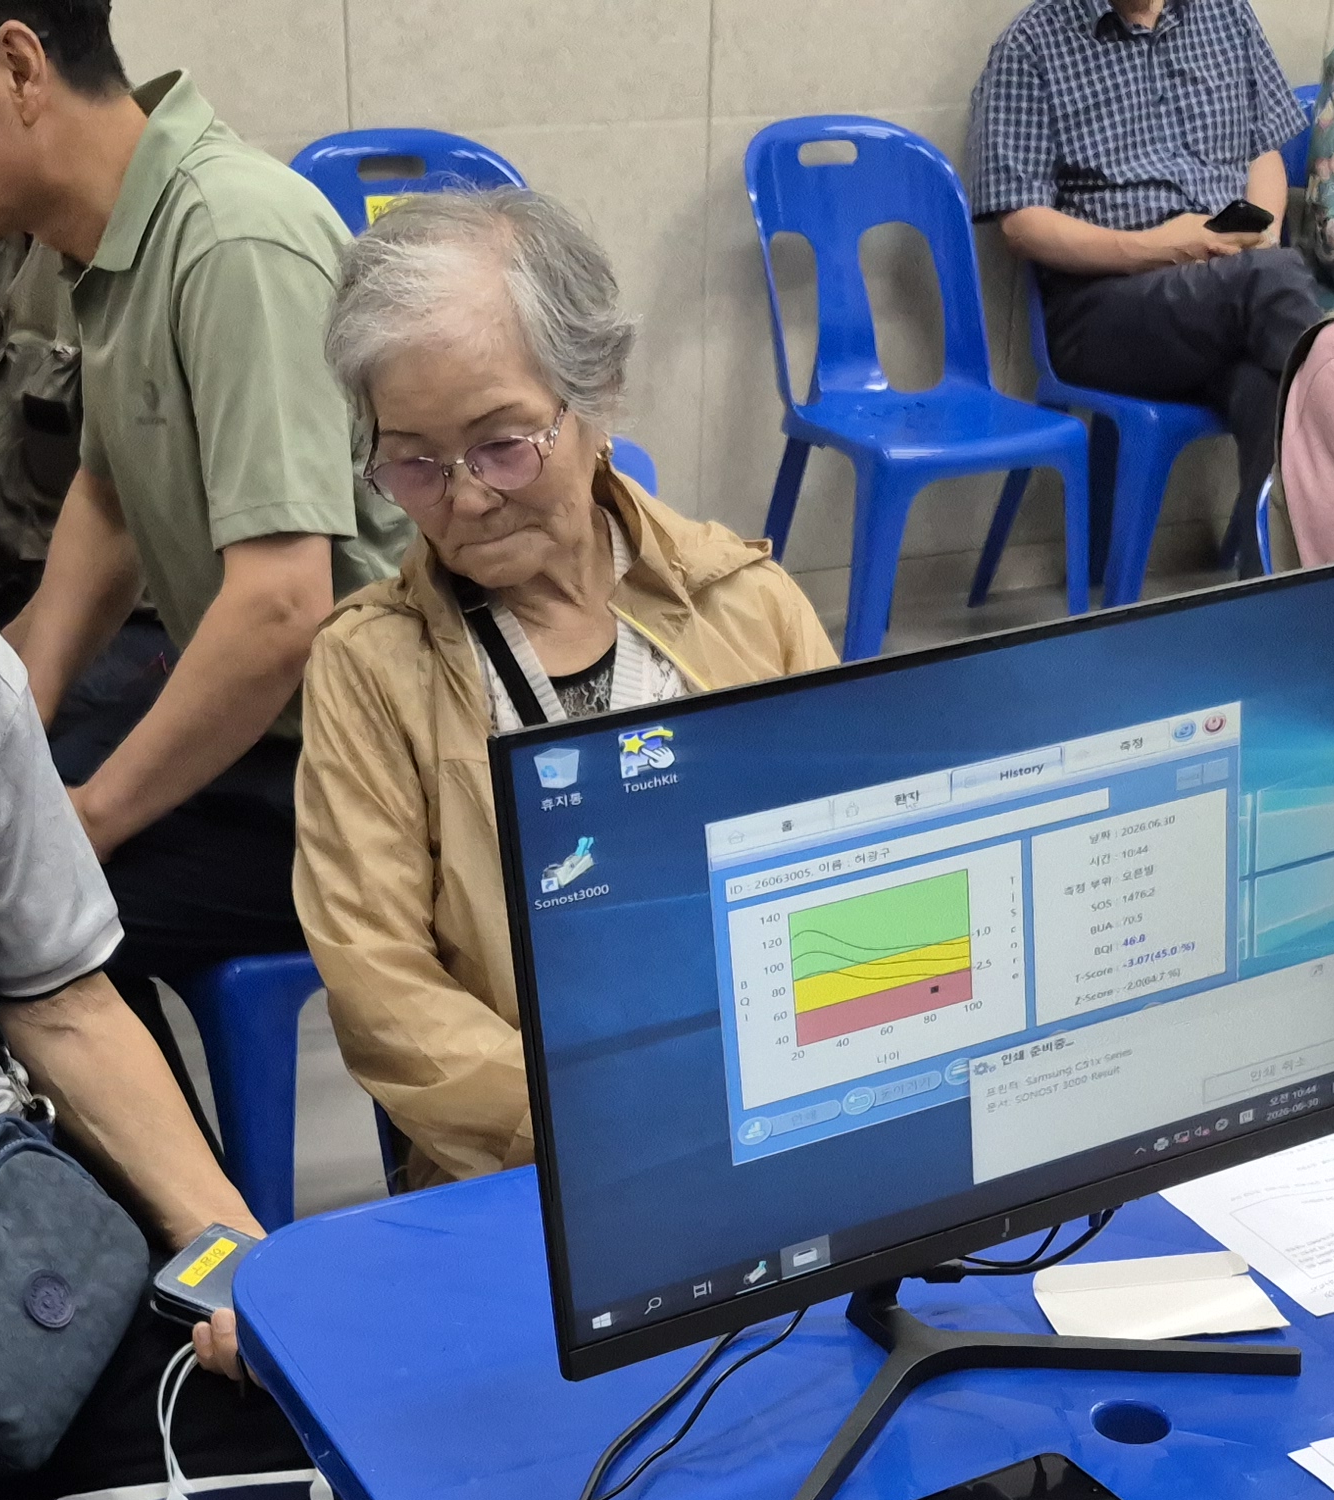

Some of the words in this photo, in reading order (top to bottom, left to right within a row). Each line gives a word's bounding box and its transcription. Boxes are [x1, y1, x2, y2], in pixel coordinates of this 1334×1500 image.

[999, 763, 1045, 781] History
[623, 773, 679, 794] TouchKit
[541, 792, 583, 811] 휴지통
[729, 883, 743, 896] ID
[818, 860, 842, 874] 이름
[534, 884, 610, 910] Sonost3000
[1091, 899, 1112, 913] SOS
[759, 912, 781, 925] 140
[1090, 921, 1114, 936] BUA
[761, 937, 783, 950] 120
[1094, 944, 1113, 957] BQI
[763, 962, 785, 975] 100
[771, 986, 787, 998] 80
[772, 1010, 788, 1022] 60
[790, 1050, 806, 1062] 20
[835, 1037, 850, 1049] 40
[879, 1025, 895, 1037] 60
[923, 1012, 938, 1024] 80
[963, 1000, 983, 1014] 100
[774, 1034, 790, 1046] 40
[876, 1051, 900, 1064] 나이
[1025, 1066, 1073, 1087] Samsung
[1104, 1049, 1134, 1063] Series
[1015, 1083, 1059, 1104] SONOST
[1062, 1074, 1089, 1090] 3000
[1292, 1084, 1318, 1100] 10:44
[1266, 1097, 1319, 1121] 2026-06-30
